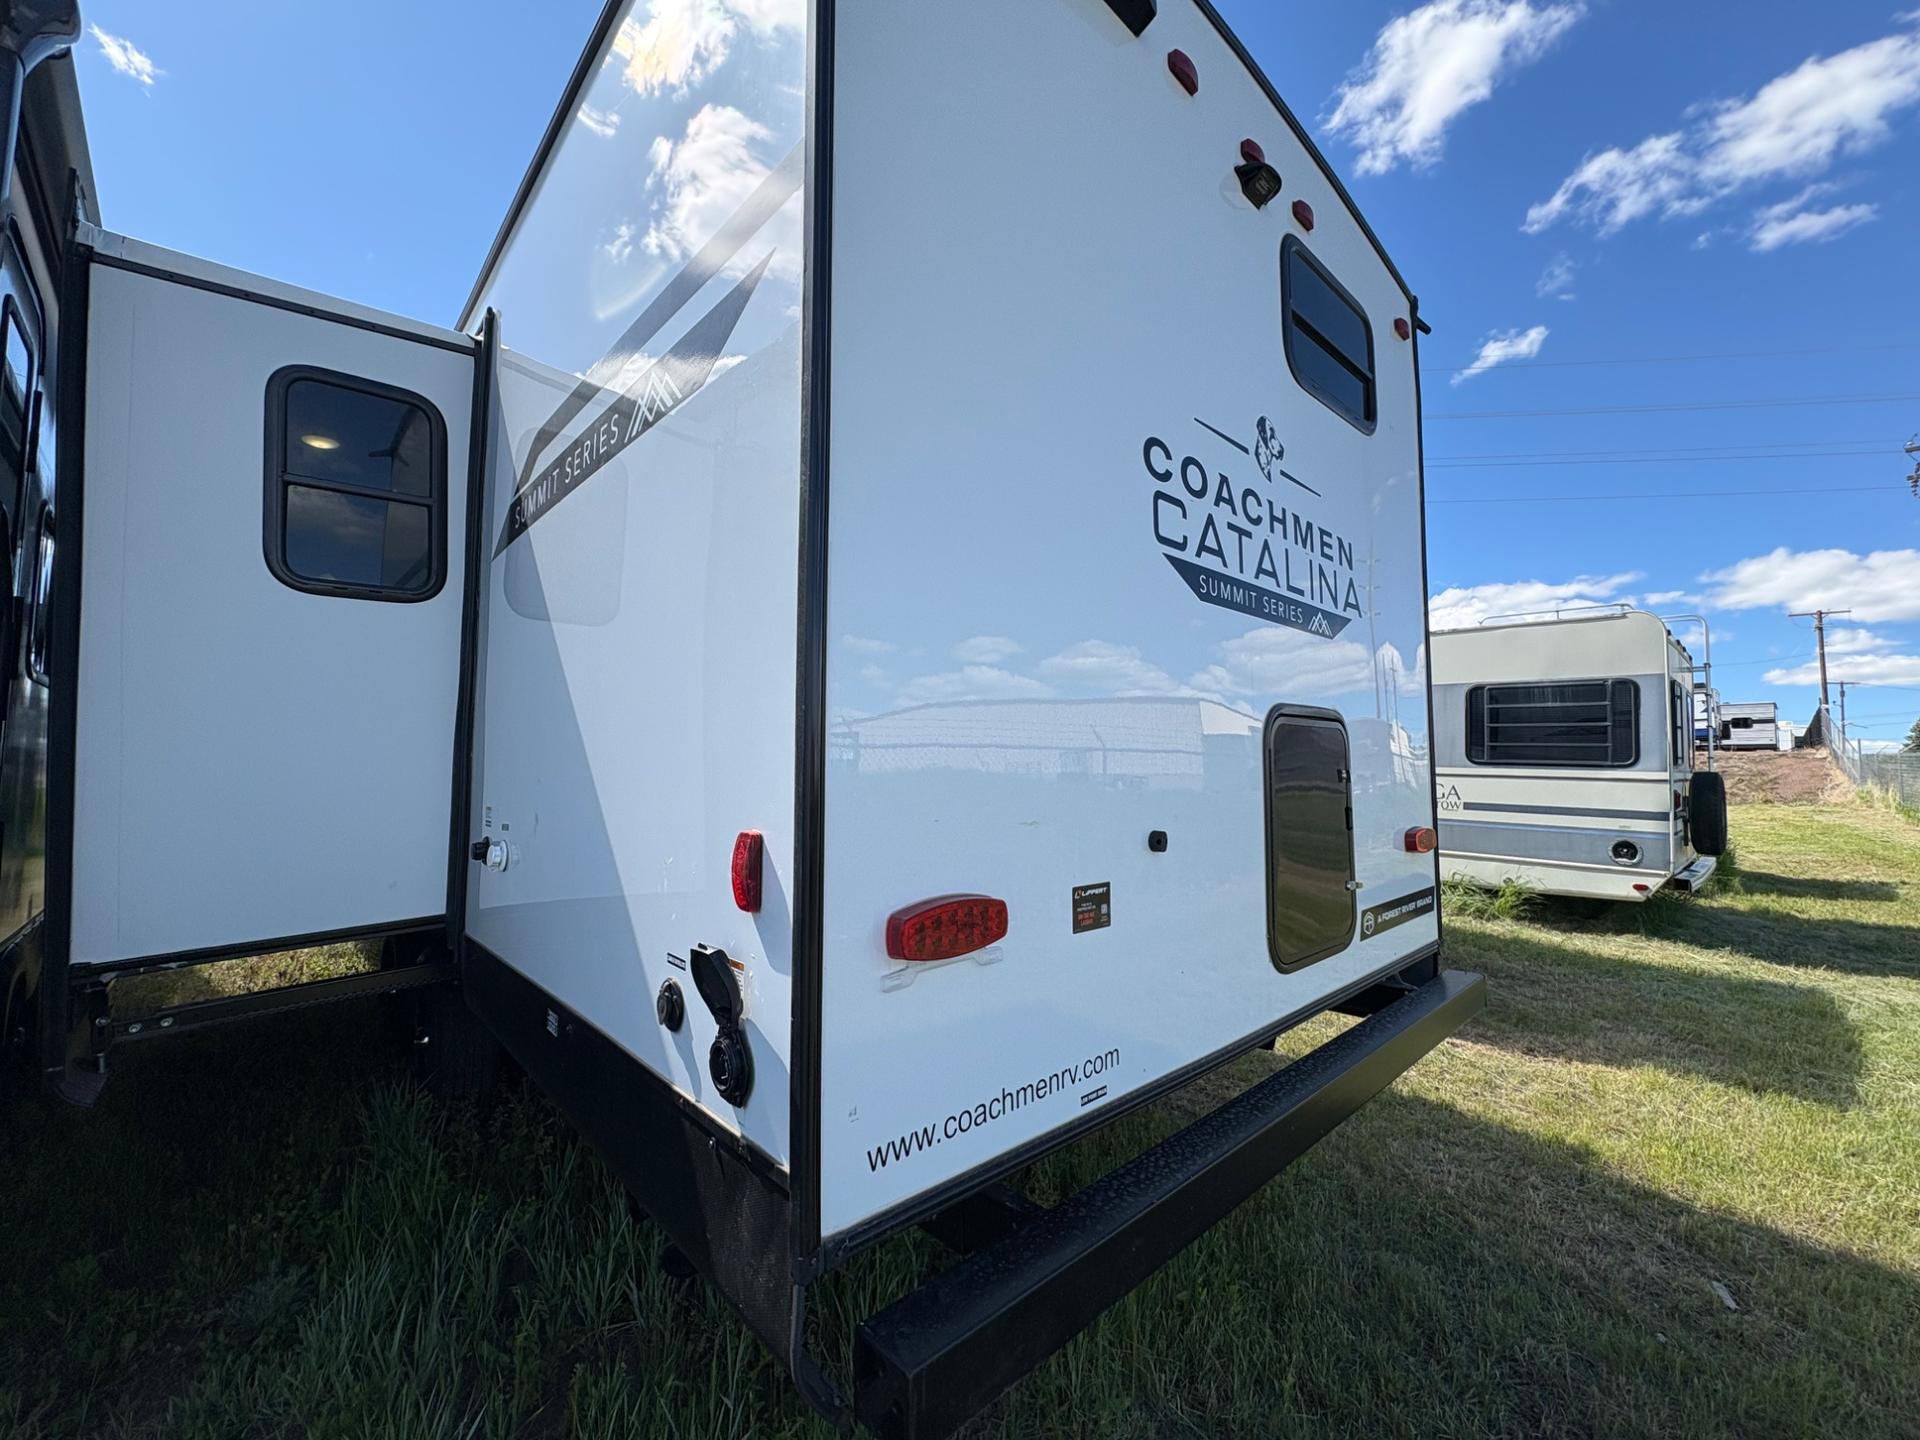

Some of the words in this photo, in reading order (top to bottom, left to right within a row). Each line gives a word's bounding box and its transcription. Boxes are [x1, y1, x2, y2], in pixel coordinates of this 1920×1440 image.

[514, 468, 560, 529] SUMMIT
[565, 414, 619, 484] SERIES
[1142, 436, 1354, 572] COACHMEN
[1152, 490, 1362, 618] CATALINA
[1199, 574, 1258, 609] SUMMIT
[1263, 596, 1304, 624] SERIES
[1382, 907, 1402, 920] FOREST
[1402, 901, 1416, 913] RIVER
[866, 1048, 1120, 1172] www.coachmenrv.com
